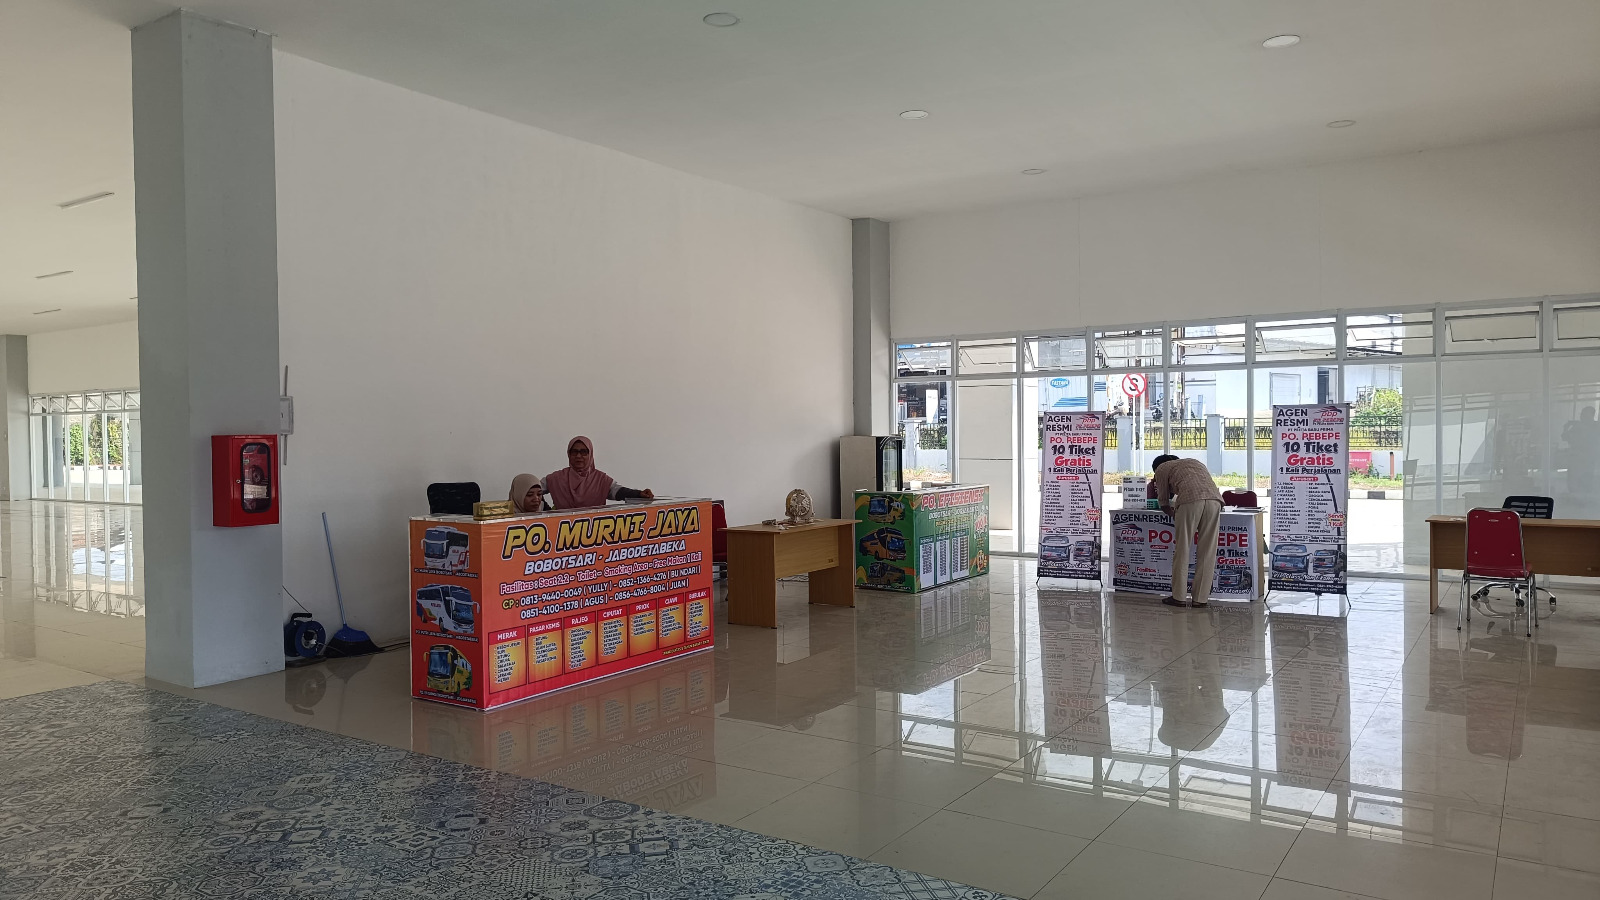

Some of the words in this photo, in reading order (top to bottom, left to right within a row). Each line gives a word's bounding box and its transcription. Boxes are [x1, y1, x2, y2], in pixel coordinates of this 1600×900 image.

[1277, 409, 1308, 418] AGEN
[1046, 424, 1073, 432] RESMI
[1276, 419, 1309, 427] RESMI
[1281, 433, 1299, 441] PO.
[1302, 433, 1341, 441] PEBEPE
[1051, 445, 1066, 455] 10
[1069, 445, 1099, 455] Tiket
[1282, 442, 1301, 453] 10
[1304, 442, 1339, 453] Tiket
[1055, 456, 1092, 467] Gratis
[1287, 454, 1334, 466] Gratis
[1301, 467, 1342, 475] Perjalanan
[921, 495, 937, 512] PO.
[937, 489, 985, 508] EFISIENSI
[1114, 514, 1141, 523] AGEN
[1142, 515, 1172, 523] RESMI
[502, 523, 551, 560] PO.
[556, 513, 647, 552] MURNI
[648, 507, 700, 540] JAYA
[1149, 530, 1176, 544] PO.
[524, 553, 597, 575] BOBOTSARI
[605, 540, 687, 563] JABODETABEKA
[1227, 549, 1249, 558] Tiket
[1217, 557, 1246, 565] Gratis
[539, 577, 557, 588] Seat
[557, 573, 570, 586] 2.2
[577, 568, 597, 582] Toilet
[603, 564, 632, 578] Smoking
[632, 561, 649, 574] Area
[653, 558, 668, 571] Free
[667, 555, 686, 568] Makan
[520, 586, 583, 606] 0813-9440-0049
[618, 573, 667, 589] 0852-1366-4276
[520, 602, 579, 620] 0851-4100-1378
[602, 608, 623, 618] CIPUTAT
[571, 615, 589, 625] RAJEG
[529, 624, 546, 634] PASAR
[546, 621, 561, 632] KEMIS
[497, 630, 518, 641] MERAK
